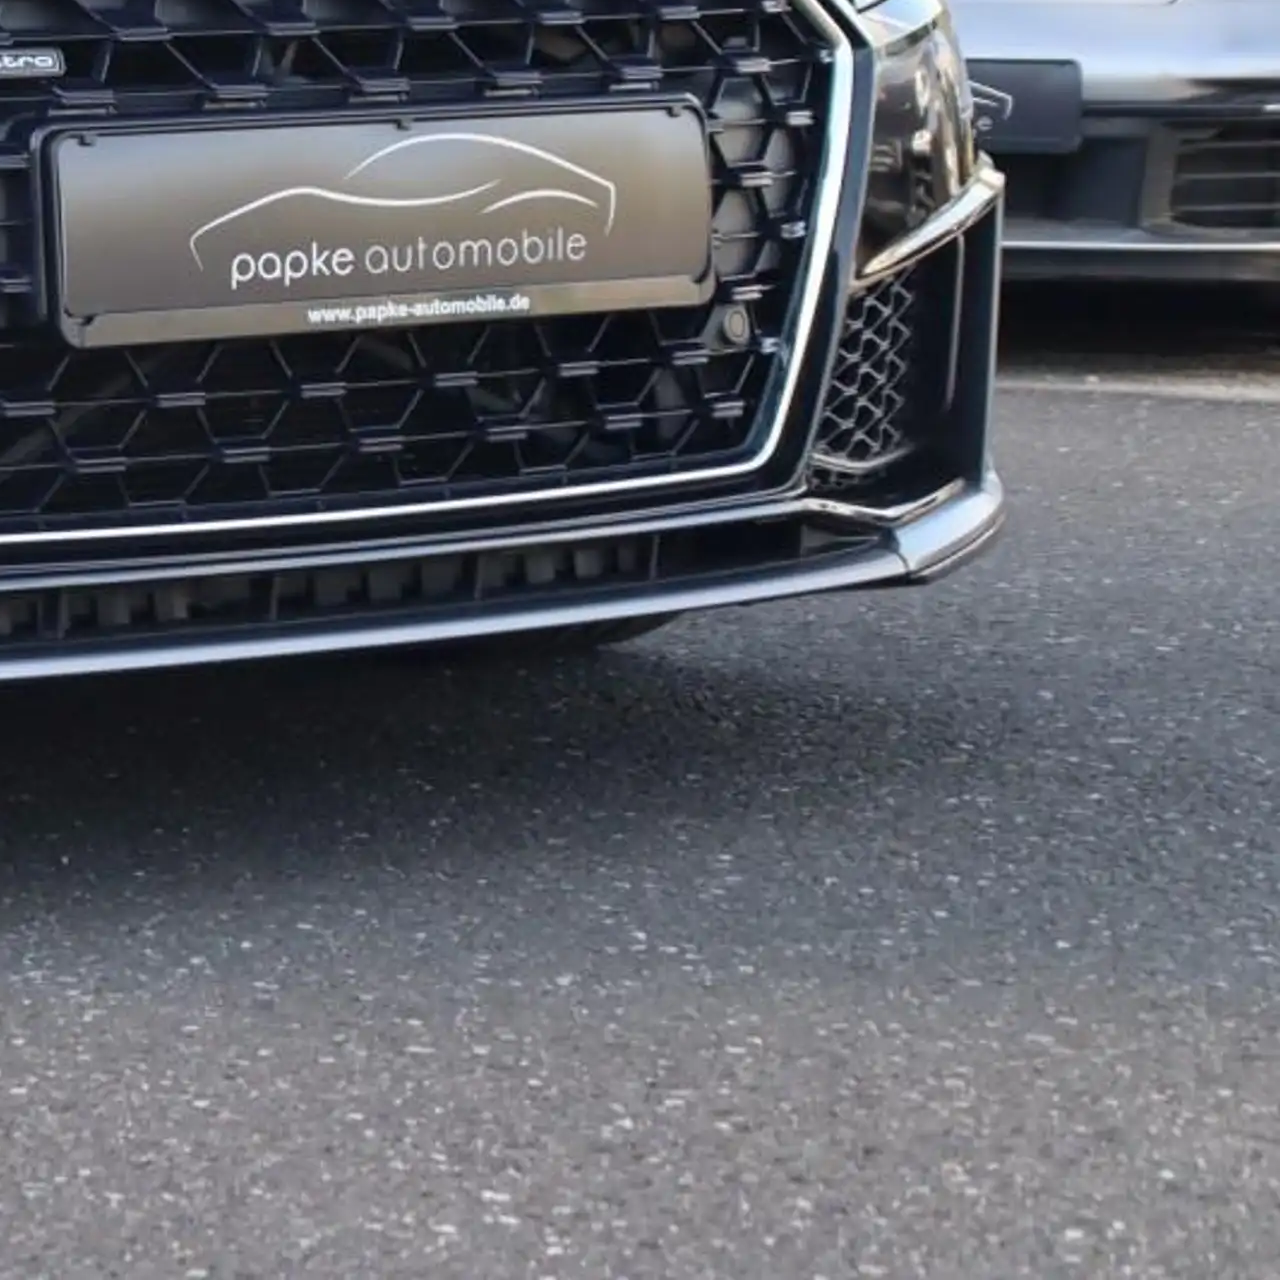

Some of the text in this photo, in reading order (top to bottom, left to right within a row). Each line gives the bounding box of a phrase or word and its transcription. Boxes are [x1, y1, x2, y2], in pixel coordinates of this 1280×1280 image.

[230, 227, 588, 291] papke automobile
[307, 293, 531, 324] www.papke-automobile.de
